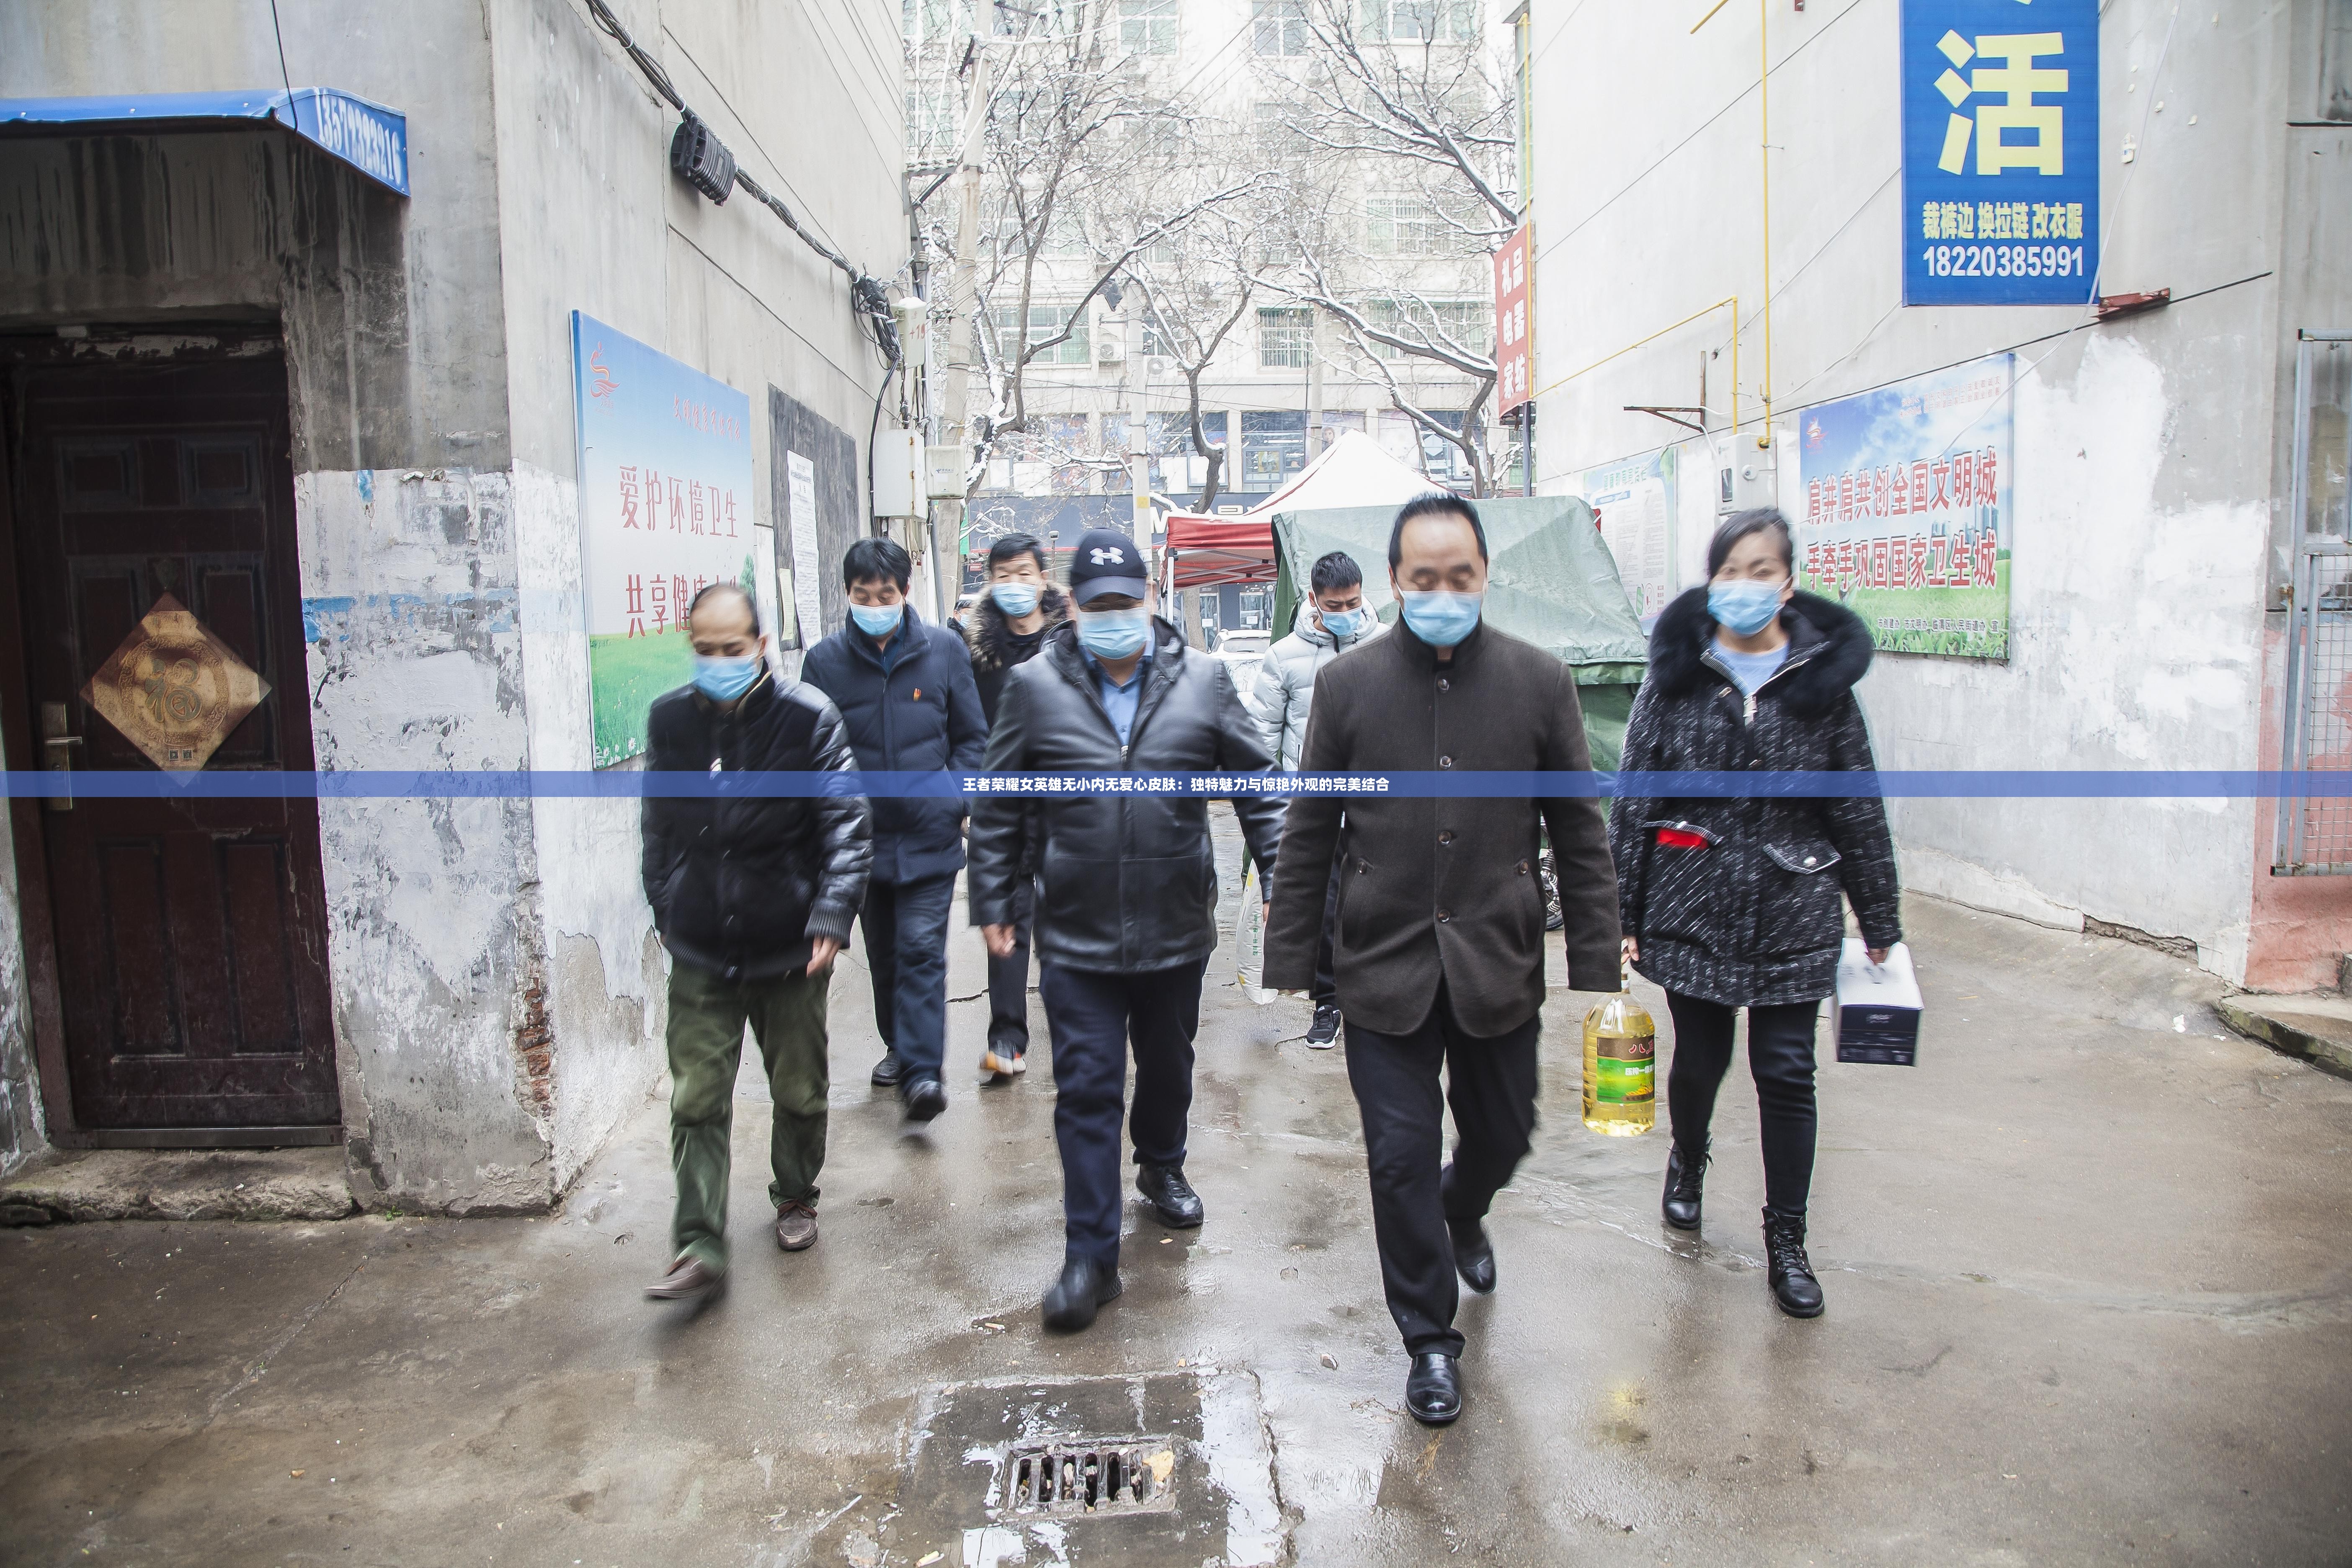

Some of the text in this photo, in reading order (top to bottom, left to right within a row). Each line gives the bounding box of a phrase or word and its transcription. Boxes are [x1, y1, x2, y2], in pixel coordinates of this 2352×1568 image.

[1934, 0, 2068, 176] 活
[1923, 201, 2083, 239] 裁裤边 换拉链 改衣服
[1501, 246, 1524, 298] 礼品
[1923, 245, 2083, 277] 18220385991
[1503, 299, 1525, 346] 电器
[1504, 353, 1526, 399] 家纺
[619, 465, 739, 538] 爱护环境卫生
[1808, 446, 1997, 524] 肩并肩共创全国文明城
[1806, 527, 1997, 591] 手牵手巩固国家卫生城
[626, 574, 737, 639] 共享健
